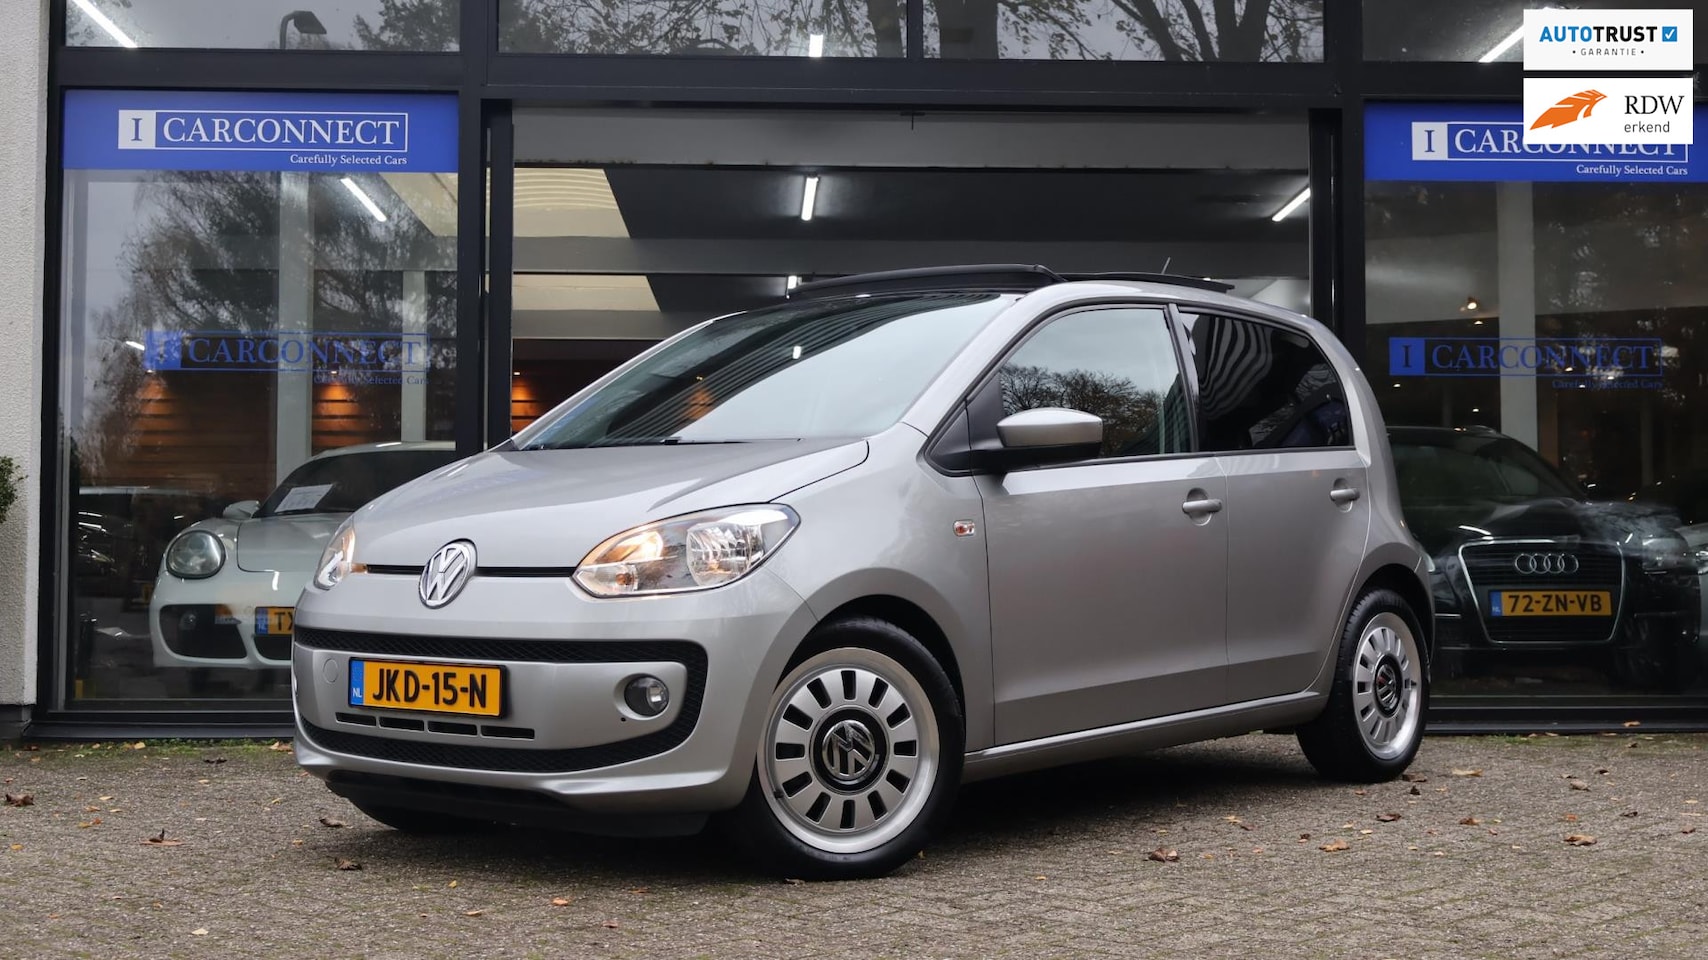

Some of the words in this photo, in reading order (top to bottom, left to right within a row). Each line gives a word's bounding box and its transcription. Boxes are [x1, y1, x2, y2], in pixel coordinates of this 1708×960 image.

[130, 117, 143, 142] I
[163, 117, 400, 145] CARCONNECT
[290, 154, 338, 167] Carefully
[340, 155, 381, 165] Selected
[384, 155, 407, 165] Cars
[1576, 164, 1622, 177] Carefully
[1624, 165, 1663, 175] Selected
[1666, 166, 1688, 176] Cars
[189, 338, 421, 365] CARCONNECT
[1431, 344, 1654, 369] CARCONNECT
[1508, 594, 1602, 613] 72-ZN-VB
[352, 687, 362, 698] NL
[373, 668, 487, 708] JKD-15-N
